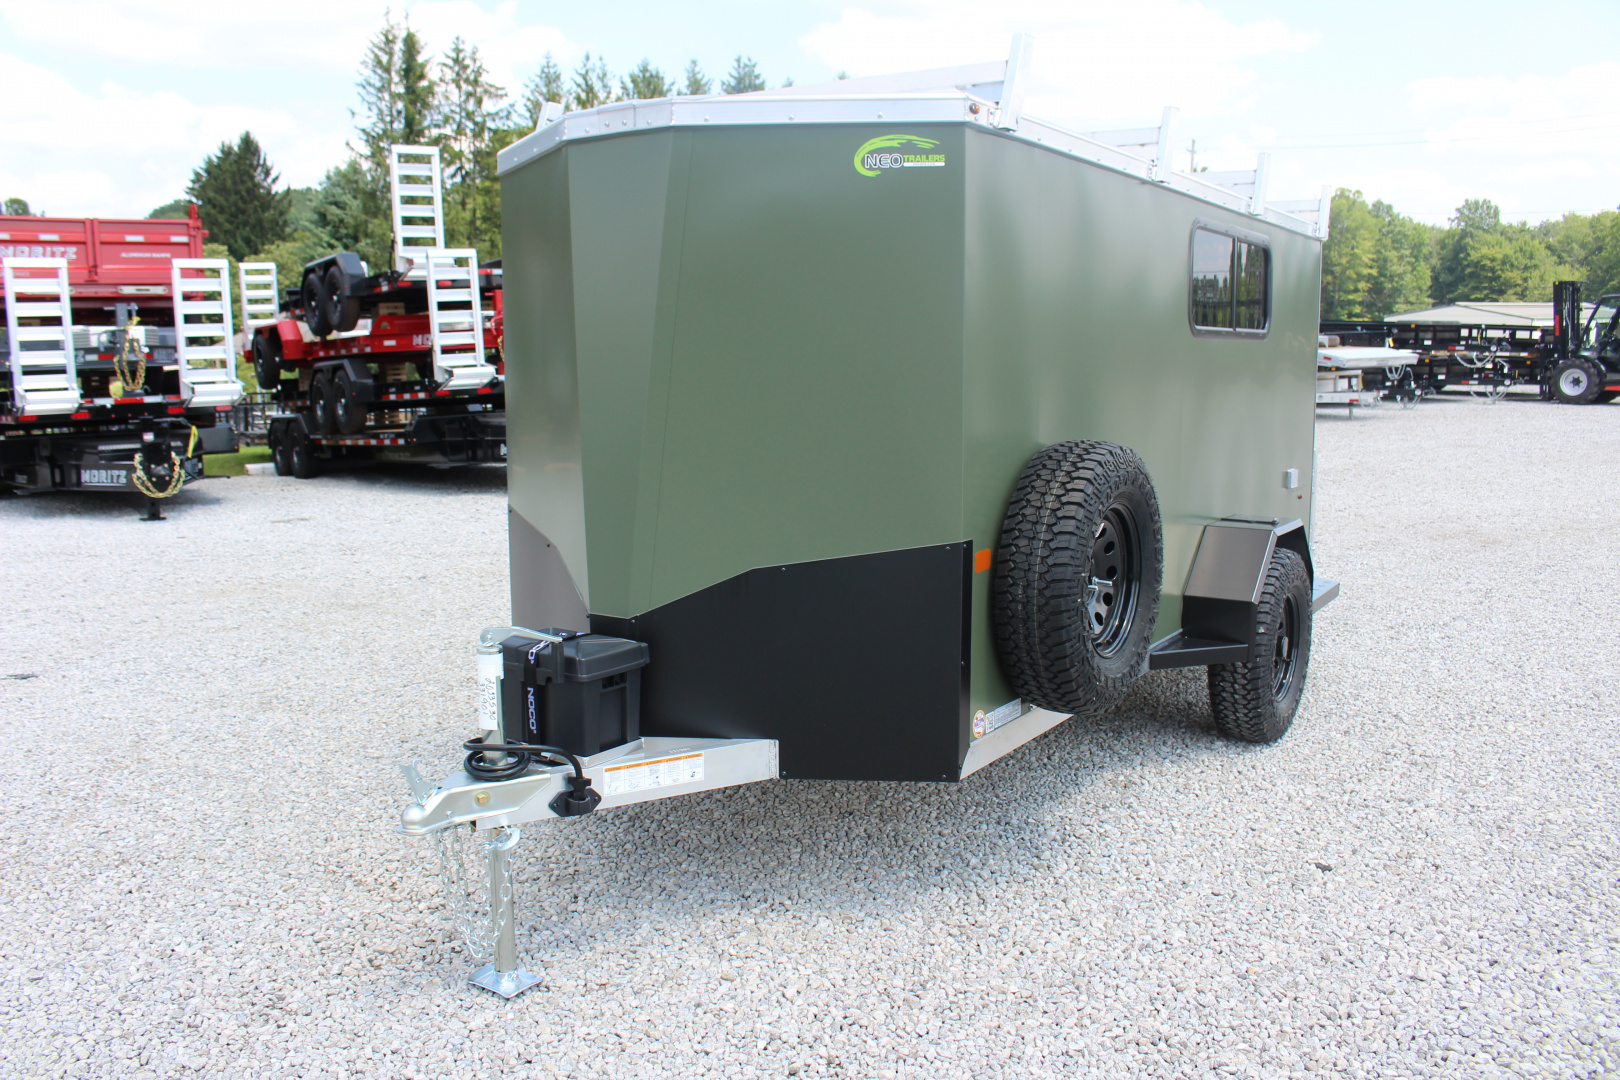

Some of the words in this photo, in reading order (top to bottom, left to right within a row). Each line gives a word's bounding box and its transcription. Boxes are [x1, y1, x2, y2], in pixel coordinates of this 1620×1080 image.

[864, 153, 904, 168] NEO
[903, 154, 945, 162] TRAILERS
[0, 245, 77, 259] MORITZ
[81, 470, 127, 483] MORITZ
[527, 687, 536, 731] NOCO
